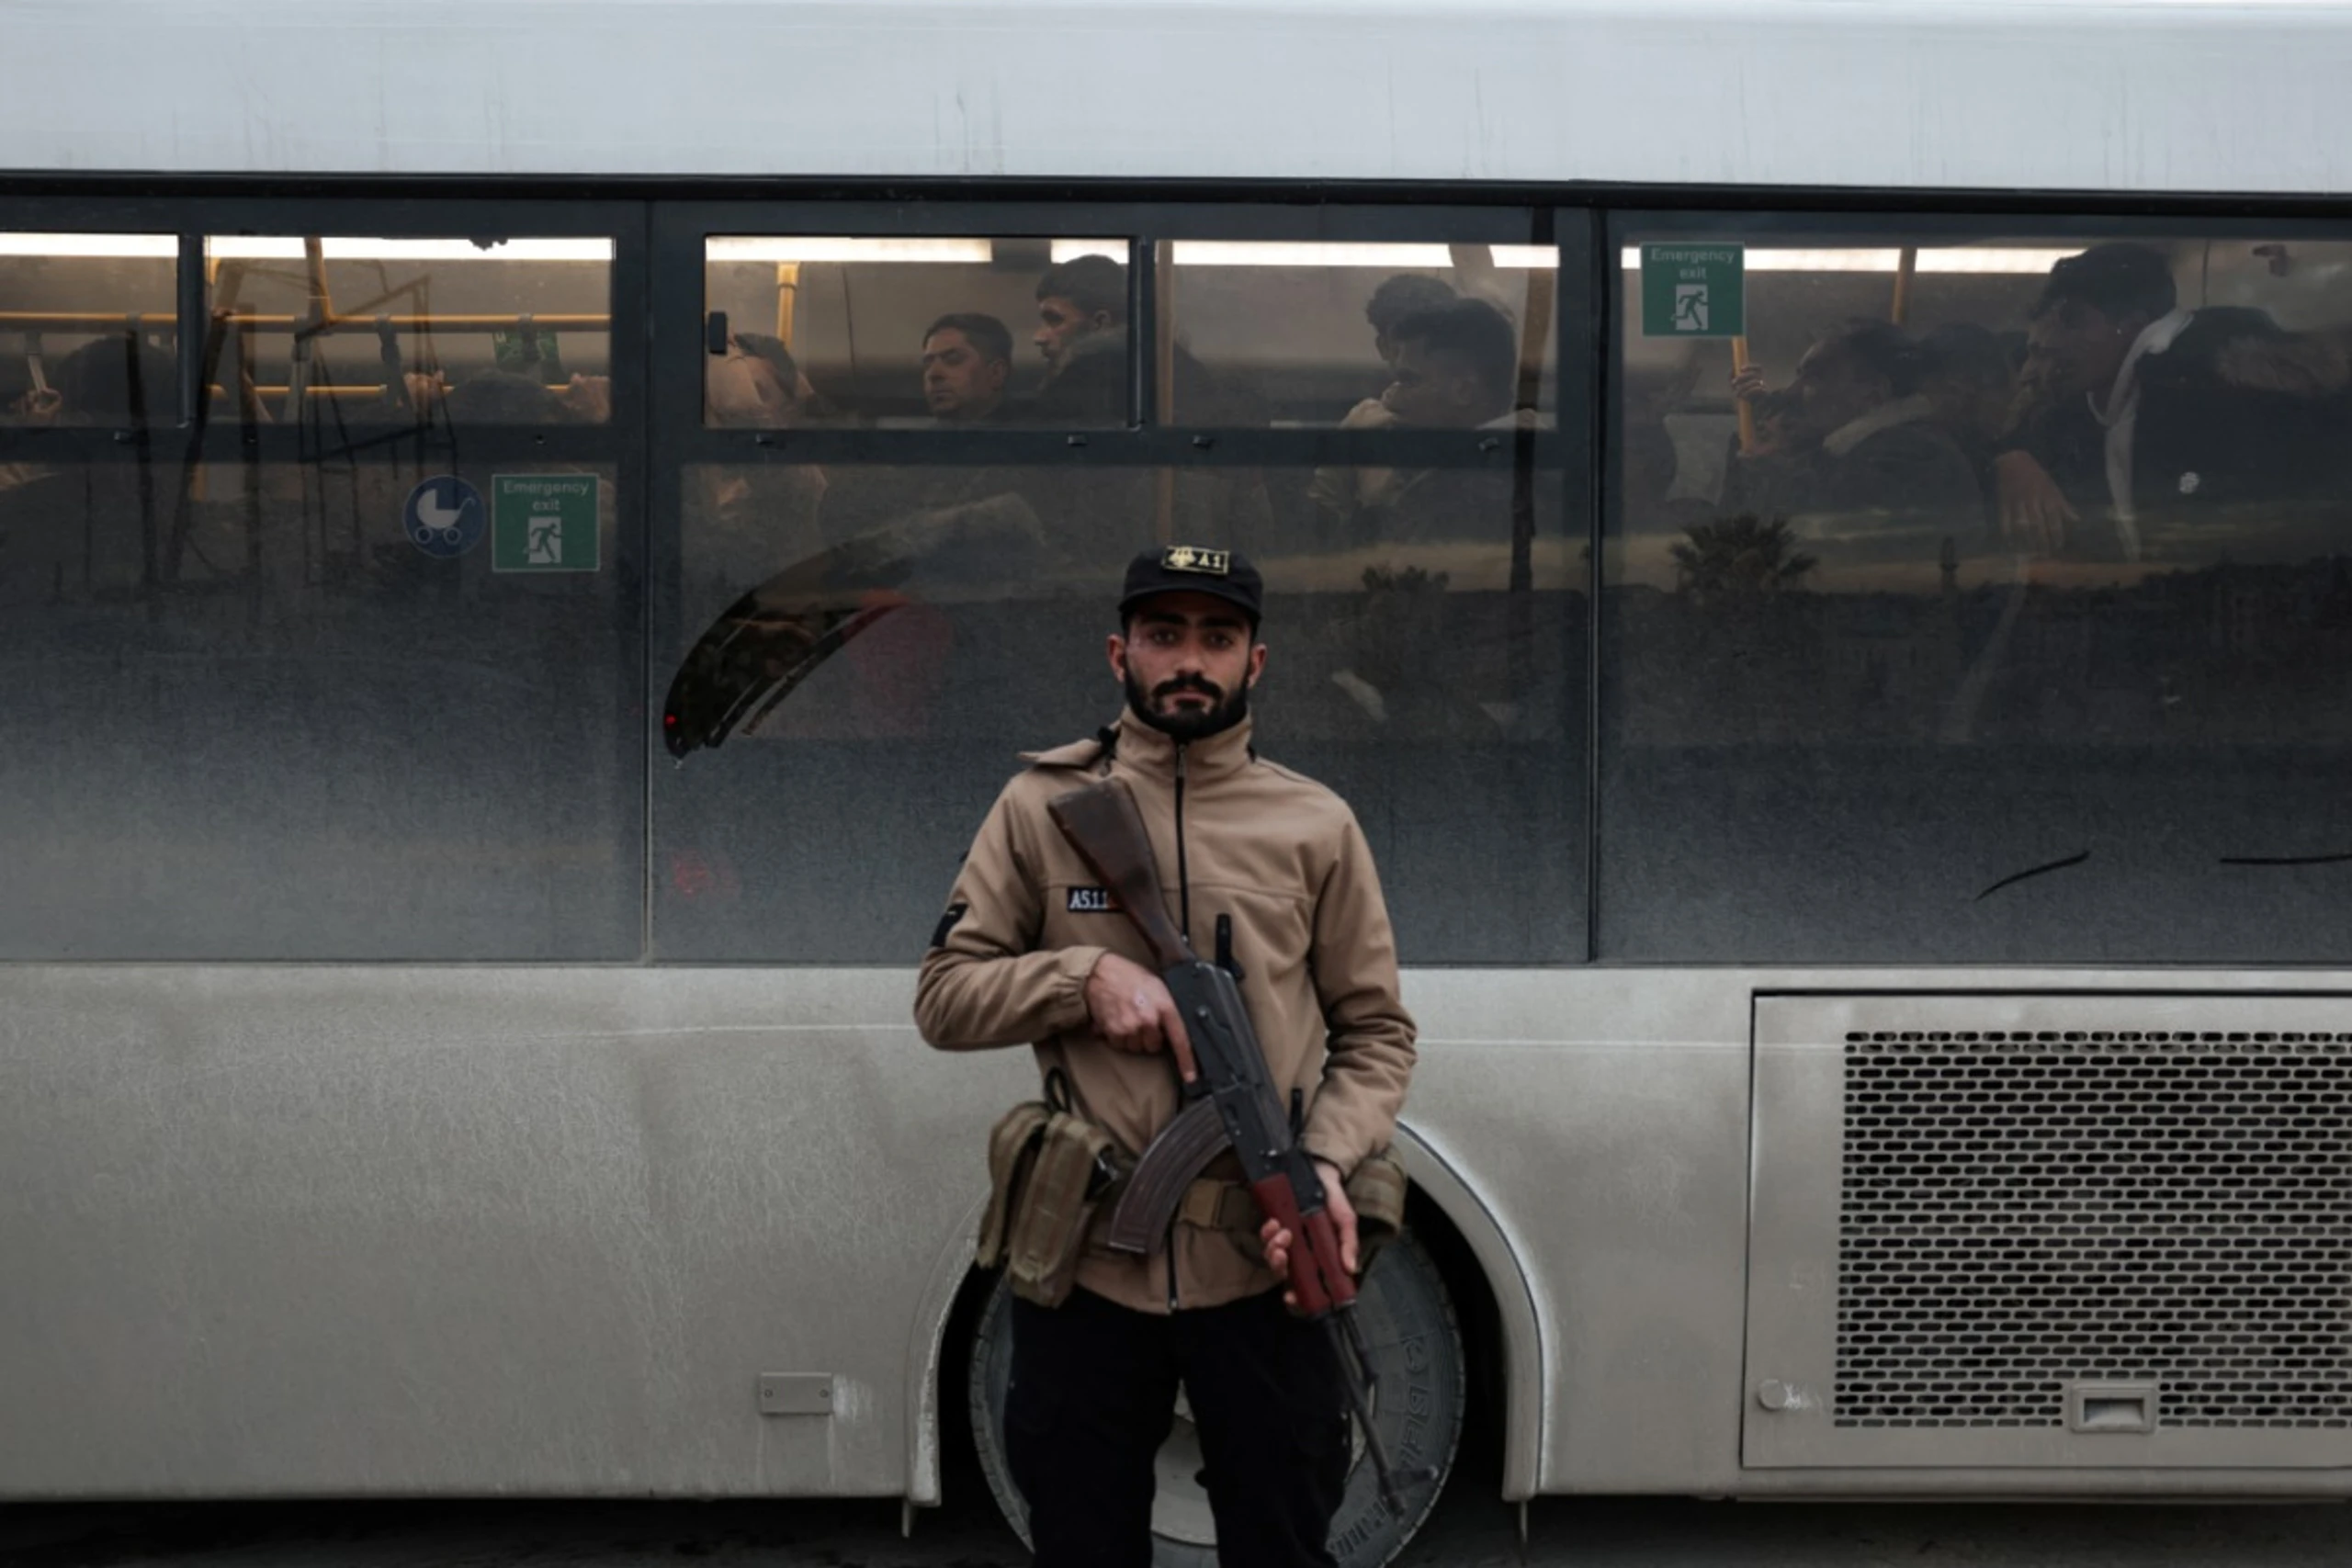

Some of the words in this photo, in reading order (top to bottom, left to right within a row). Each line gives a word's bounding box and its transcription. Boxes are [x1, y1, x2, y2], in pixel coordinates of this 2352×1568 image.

[1651, 247, 1736, 265] Emergency
[1679, 266, 1707, 280] exit
[503, 479, 589, 496] Emergency
[532, 498, 561, 512] exit
